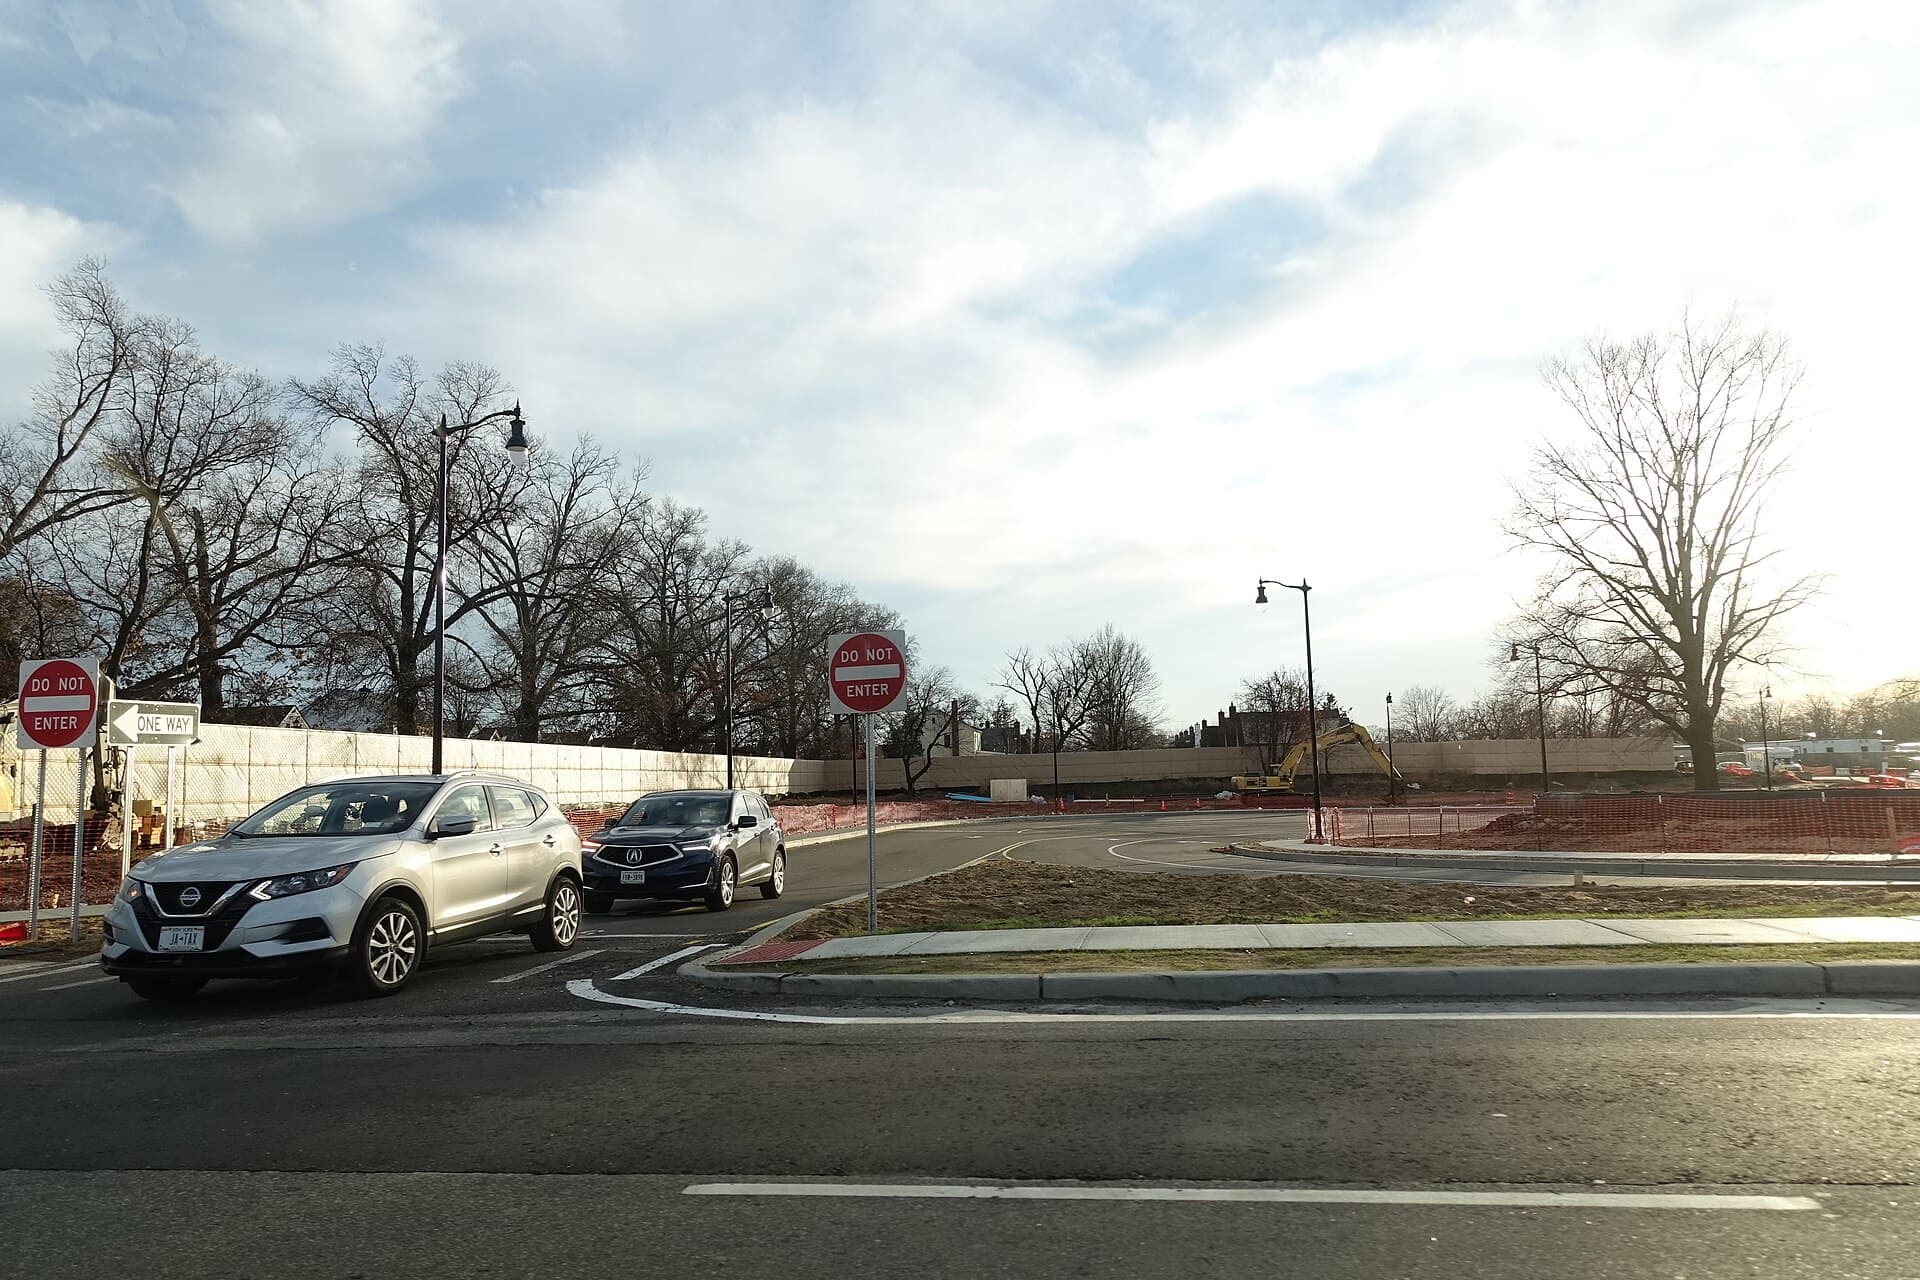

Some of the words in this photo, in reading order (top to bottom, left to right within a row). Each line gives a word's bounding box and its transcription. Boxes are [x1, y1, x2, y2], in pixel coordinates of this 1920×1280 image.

[841, 650, 858, 663] DO
[866, 648, 893, 661] NOT
[32, 678, 50, 692] DO
[58, 677, 86, 691] NOT
[847, 684, 889, 697] ENTER
[34, 716, 77, 730] ENTER
[138, 716, 161, 731] ONE
[166, 717, 190, 732] WAY
